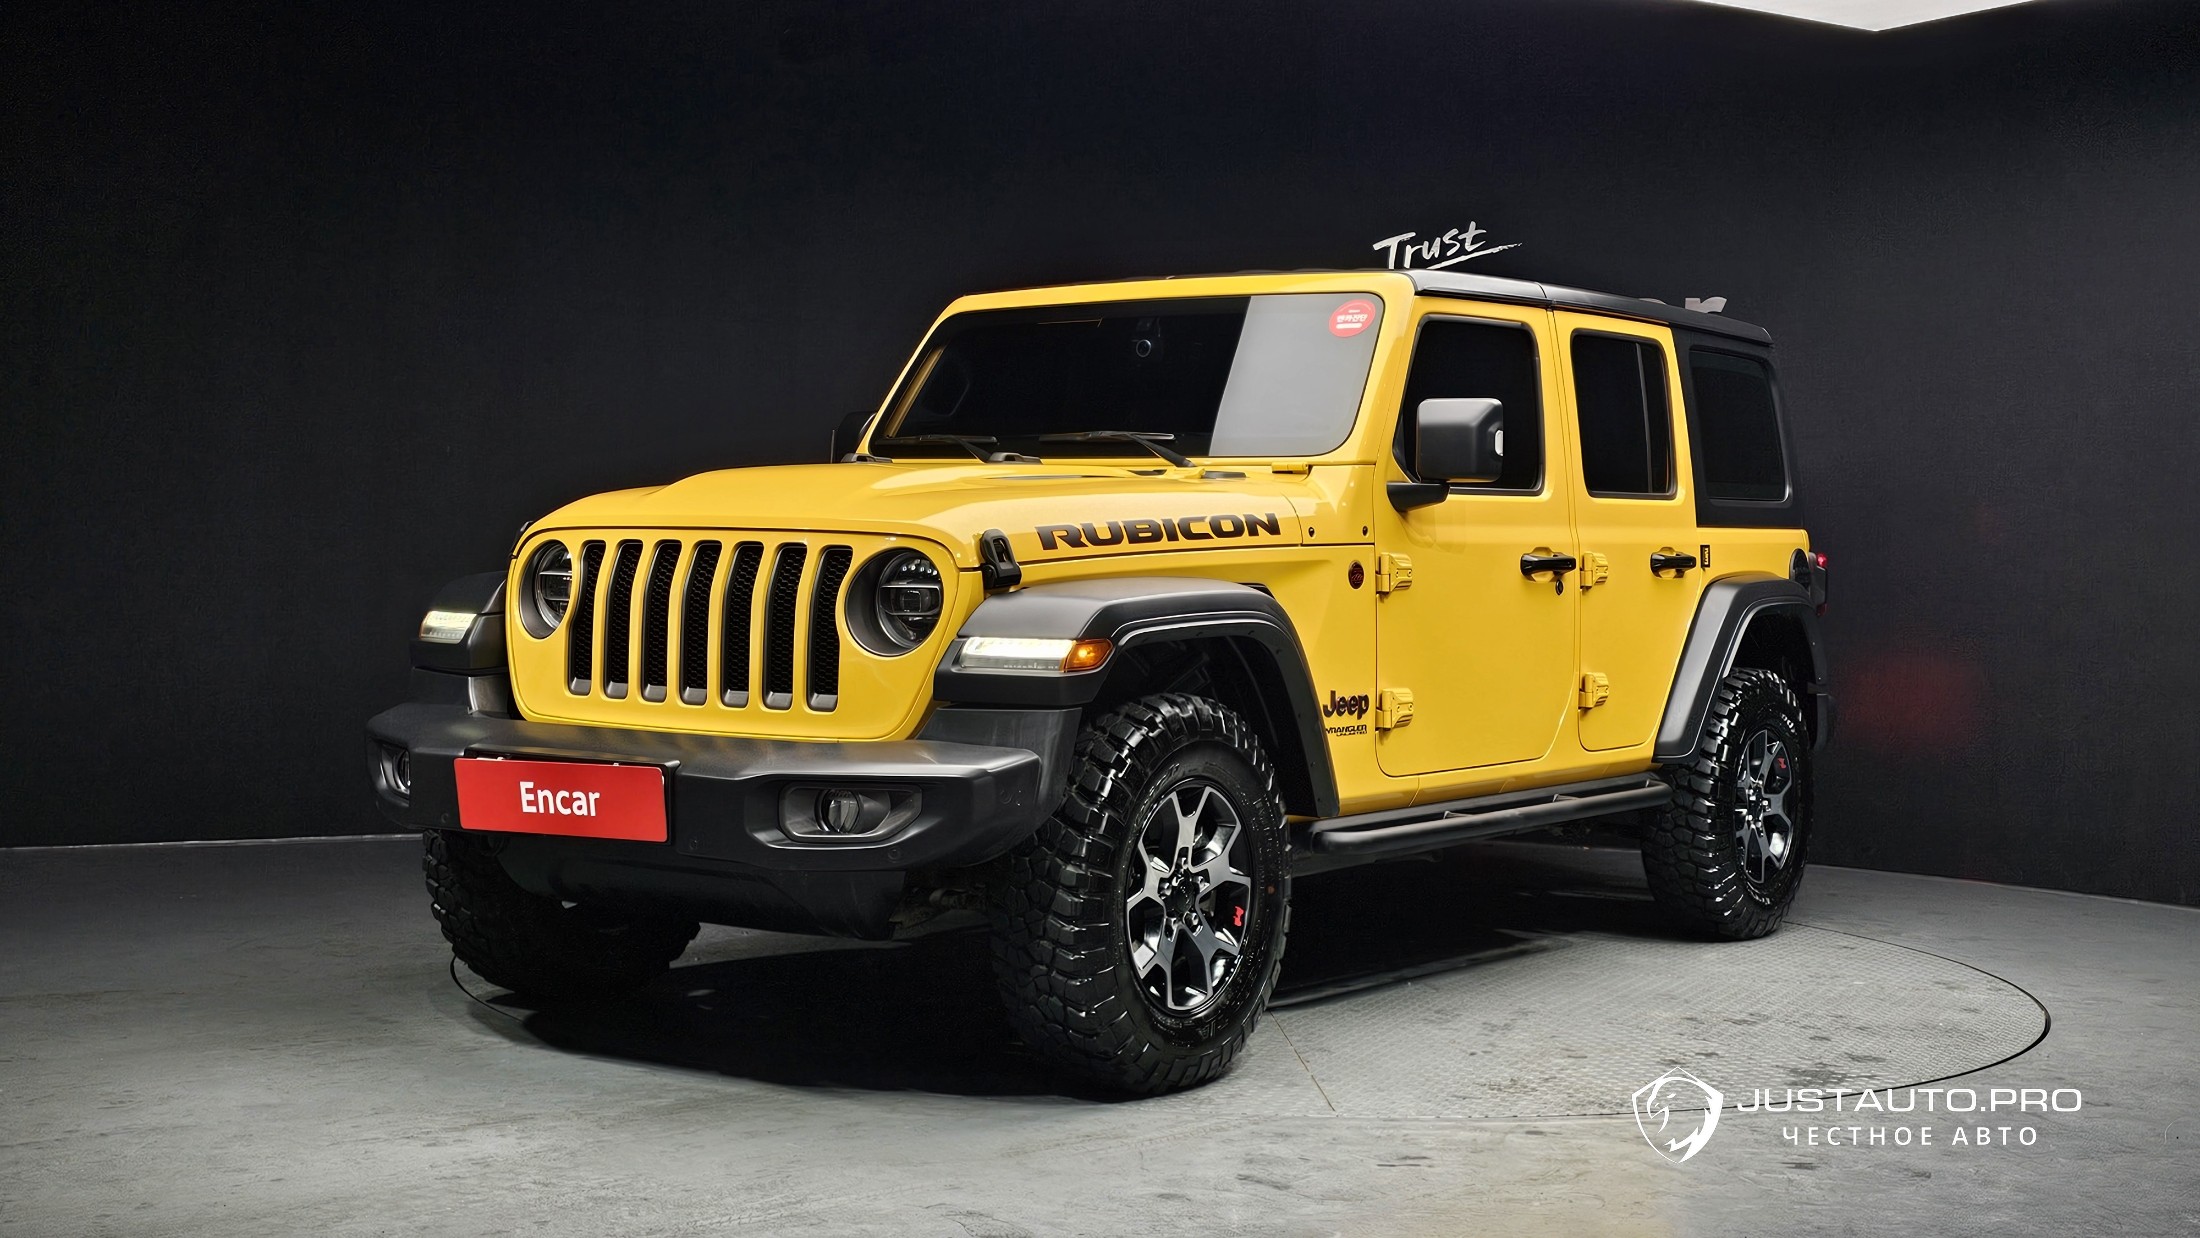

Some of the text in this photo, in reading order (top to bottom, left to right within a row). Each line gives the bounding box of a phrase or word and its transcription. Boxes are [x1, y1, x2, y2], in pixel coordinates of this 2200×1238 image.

[1372, 220, 1487, 269] Trust
[1035, 513, 1281, 550] RUBICON
[1322, 690, 1370, 720] Jeep
[519, 780, 601, 817] Encar
